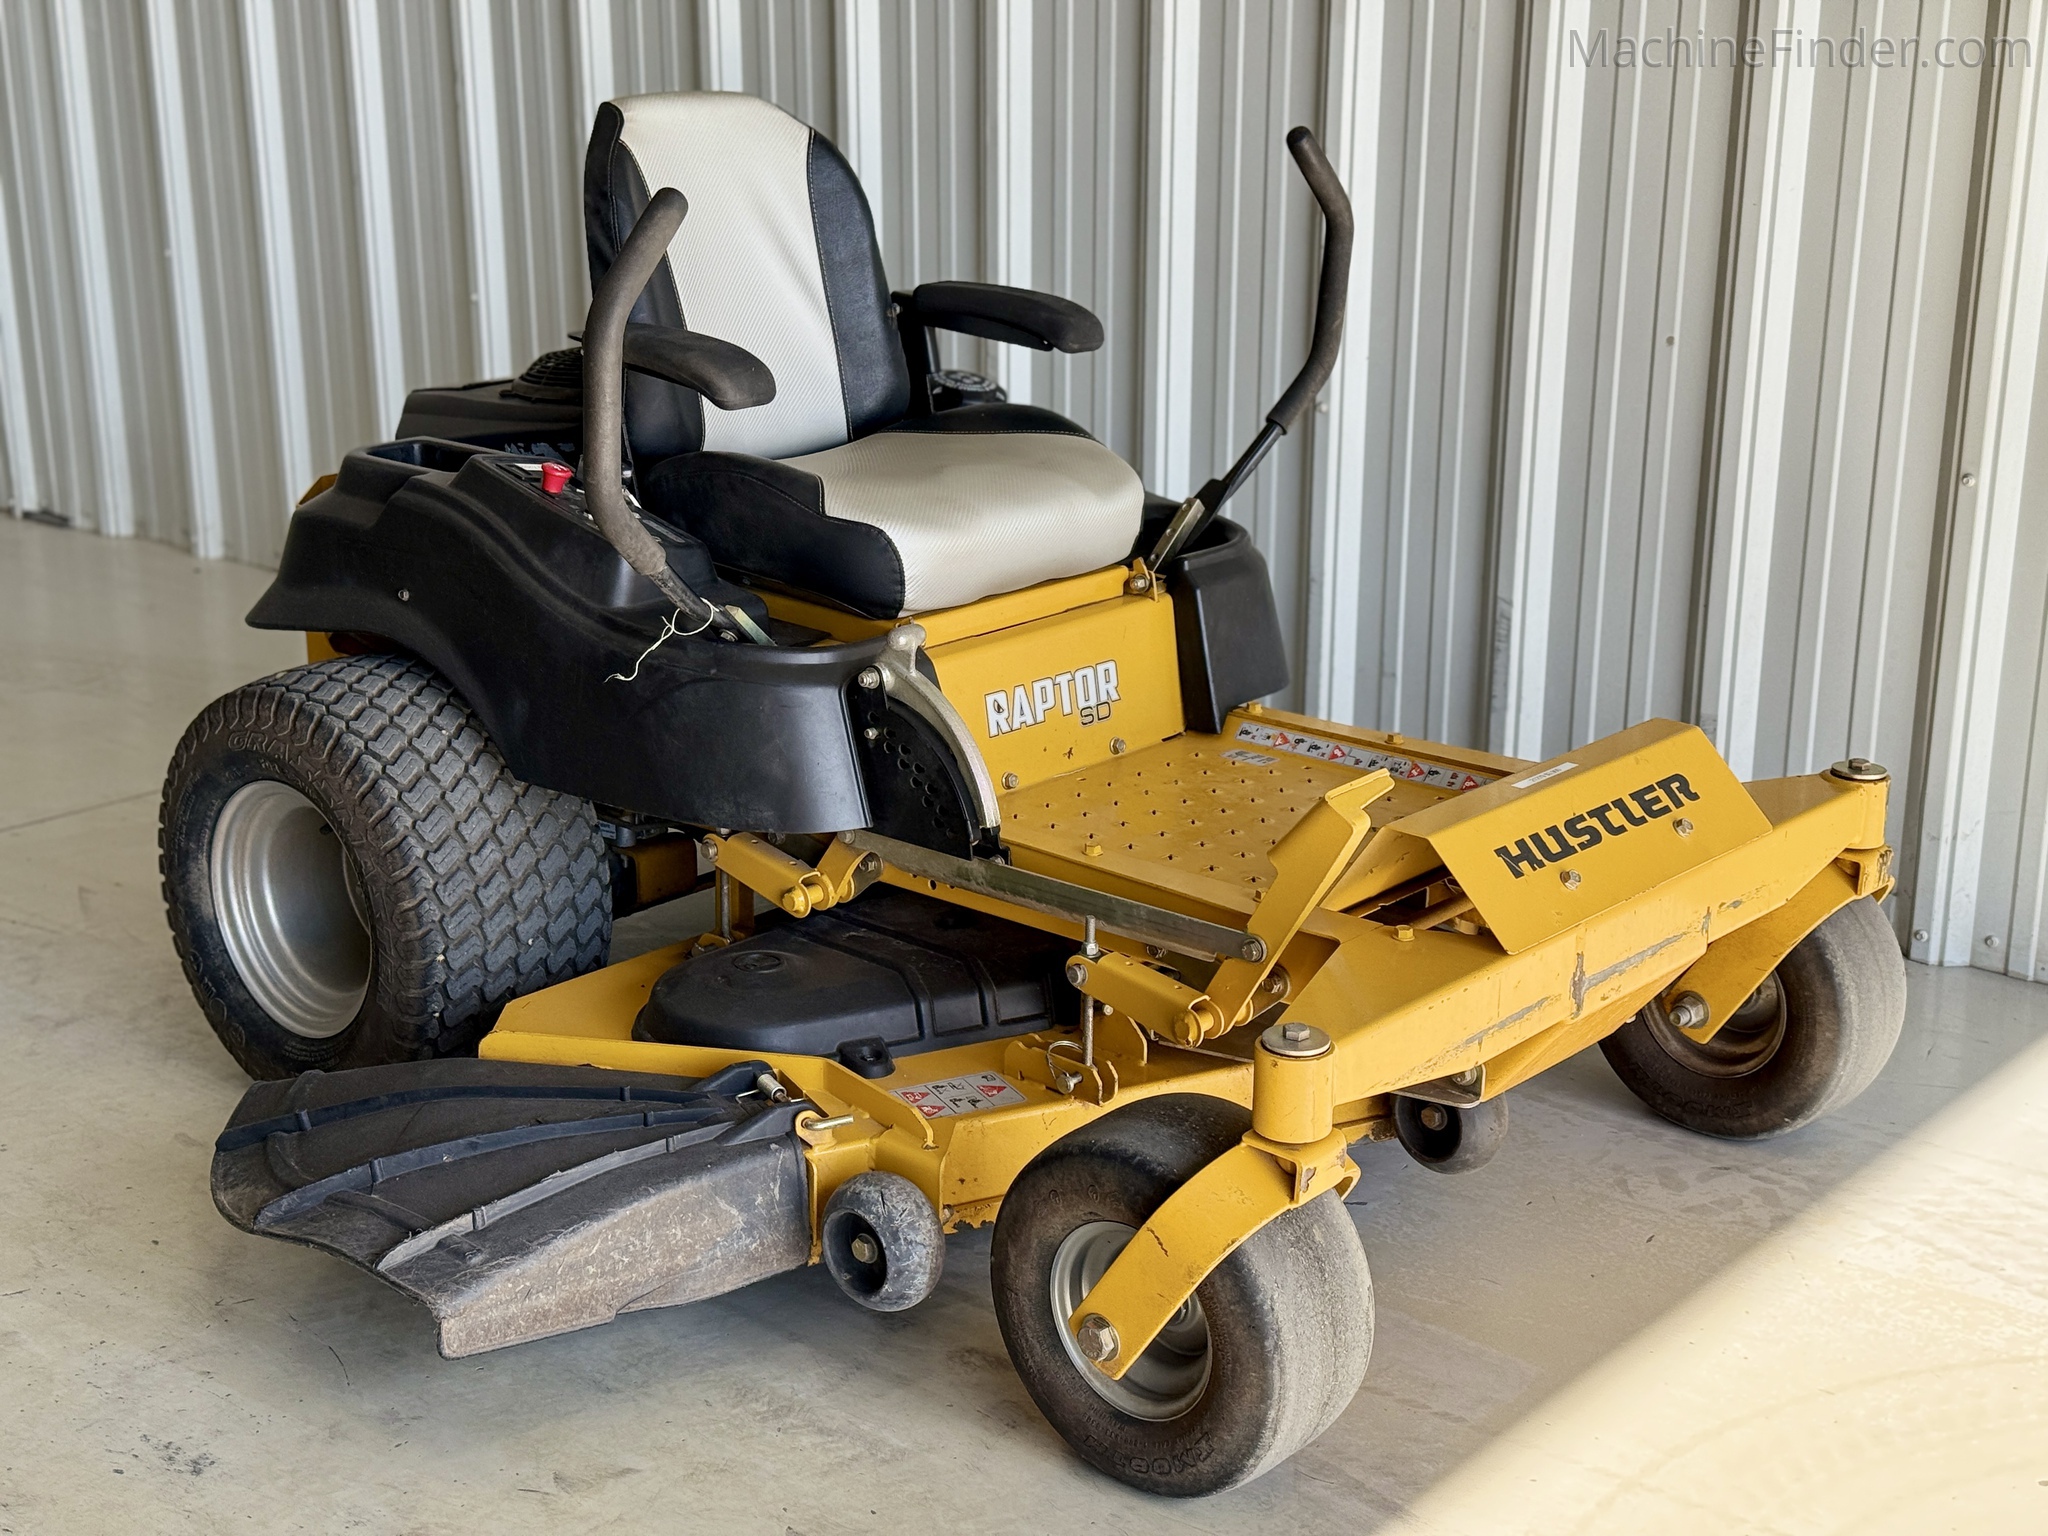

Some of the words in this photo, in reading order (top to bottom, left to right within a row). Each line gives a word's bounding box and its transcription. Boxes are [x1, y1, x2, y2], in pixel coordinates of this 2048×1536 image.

[984, 659, 1121, 738] RAPTOR
[1080, 701, 1112, 726] SD
[1494, 773, 1701, 879] HUSTLER
